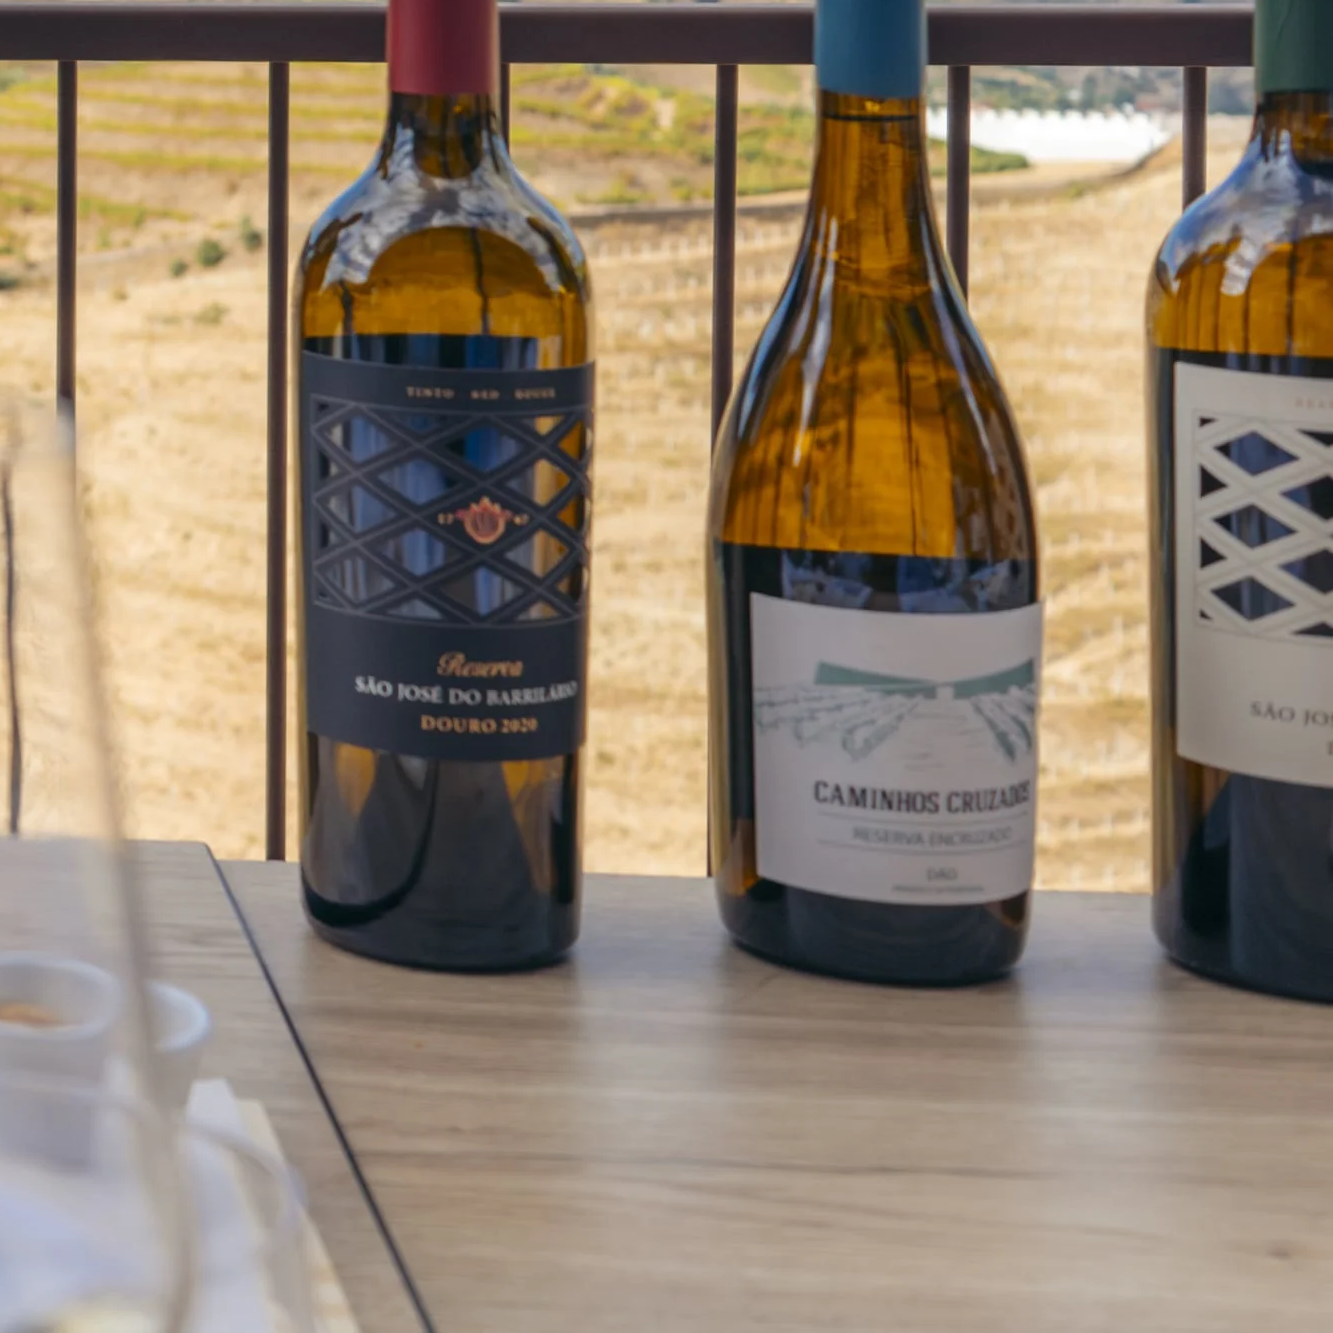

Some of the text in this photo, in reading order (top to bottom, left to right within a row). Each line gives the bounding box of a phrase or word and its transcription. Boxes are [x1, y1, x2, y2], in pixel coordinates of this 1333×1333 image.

[437, 652, 523, 677] Reserva
[355, 676, 393, 697] SÃO
[397, 683, 442, 704] JOSÉ
[449, 689, 482, 705] DO
[421, 715, 497, 734] DOURO
[814, 780, 940, 814] CAMINHOS
[853, 827, 924, 845] RESERVA
